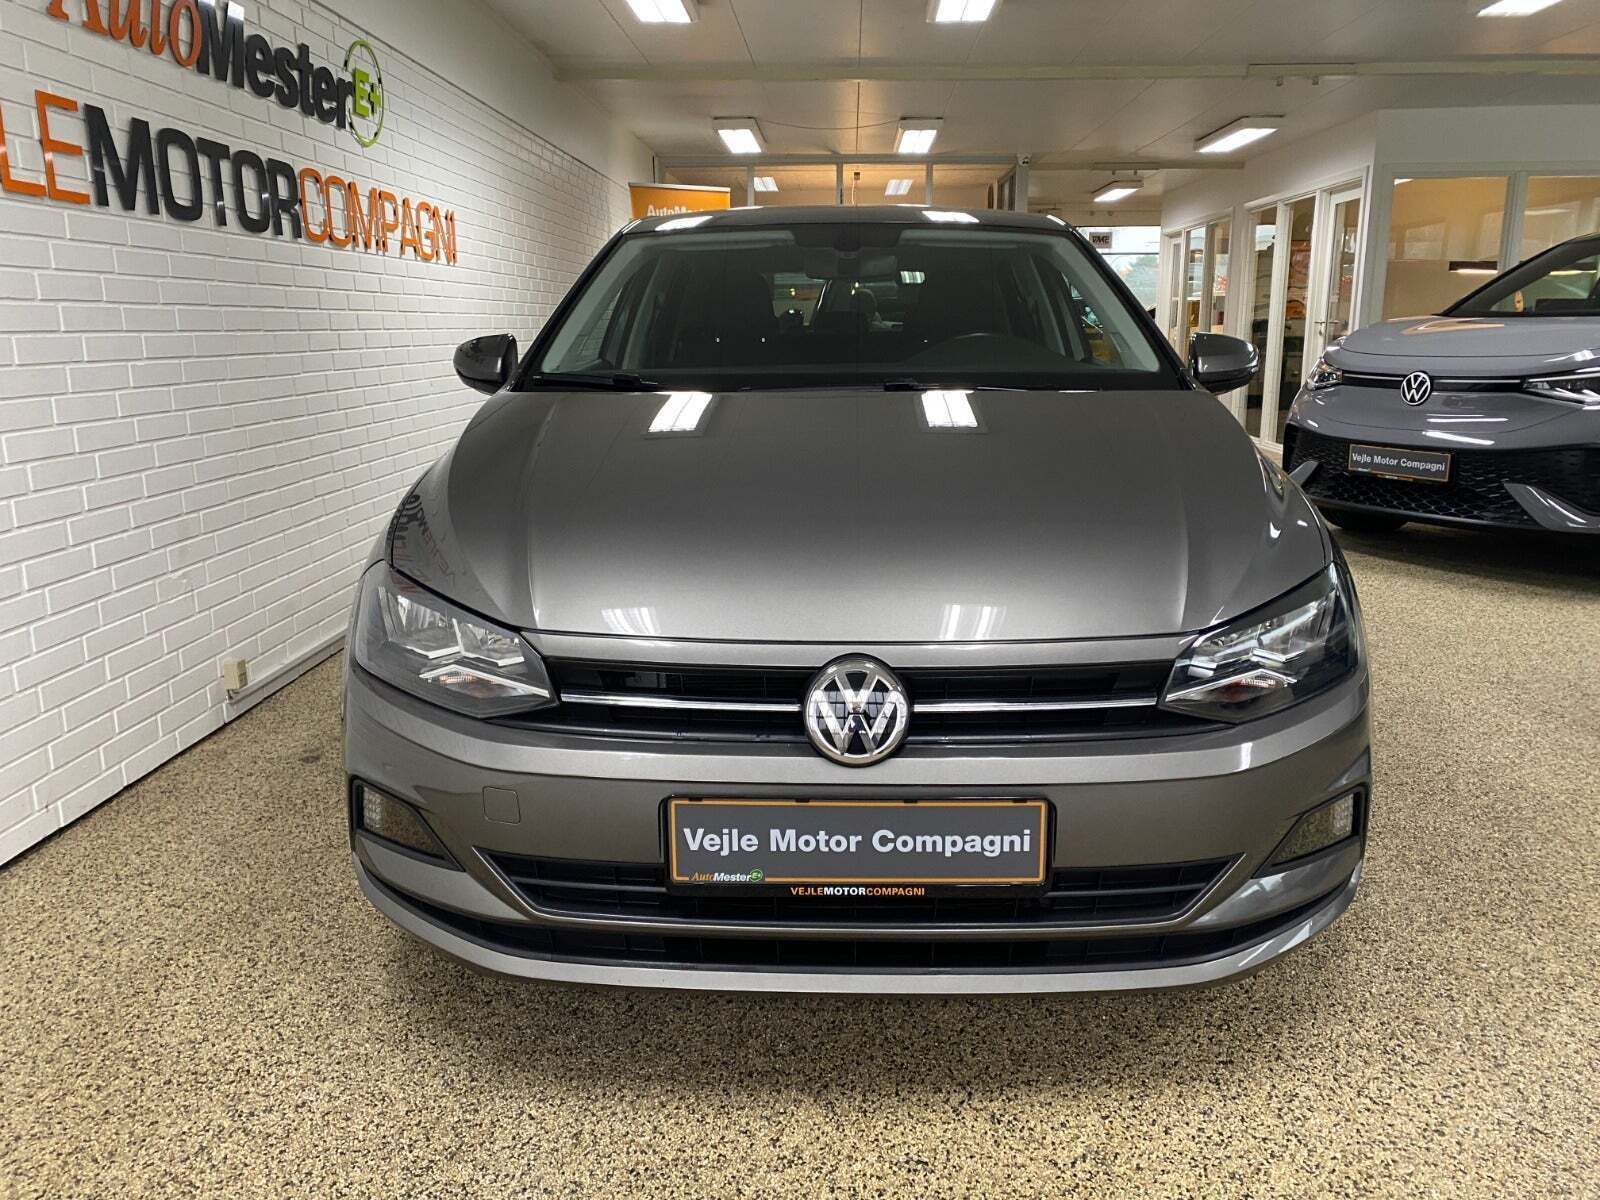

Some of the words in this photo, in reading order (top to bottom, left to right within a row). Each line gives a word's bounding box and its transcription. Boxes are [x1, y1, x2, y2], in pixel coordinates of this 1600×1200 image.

[1352, 453, 1371, 463] Vejle
[1373, 455, 1398, 466] Motor
[1400, 458, 1446, 472] Compagni
[683, 828, 759, 857] Vejle
[769, 829, 862, 853] Motor
[871, 829, 1031, 858] Compagni
[790, 886, 926, 896] VEJLEMOTORCOMPAGNI
